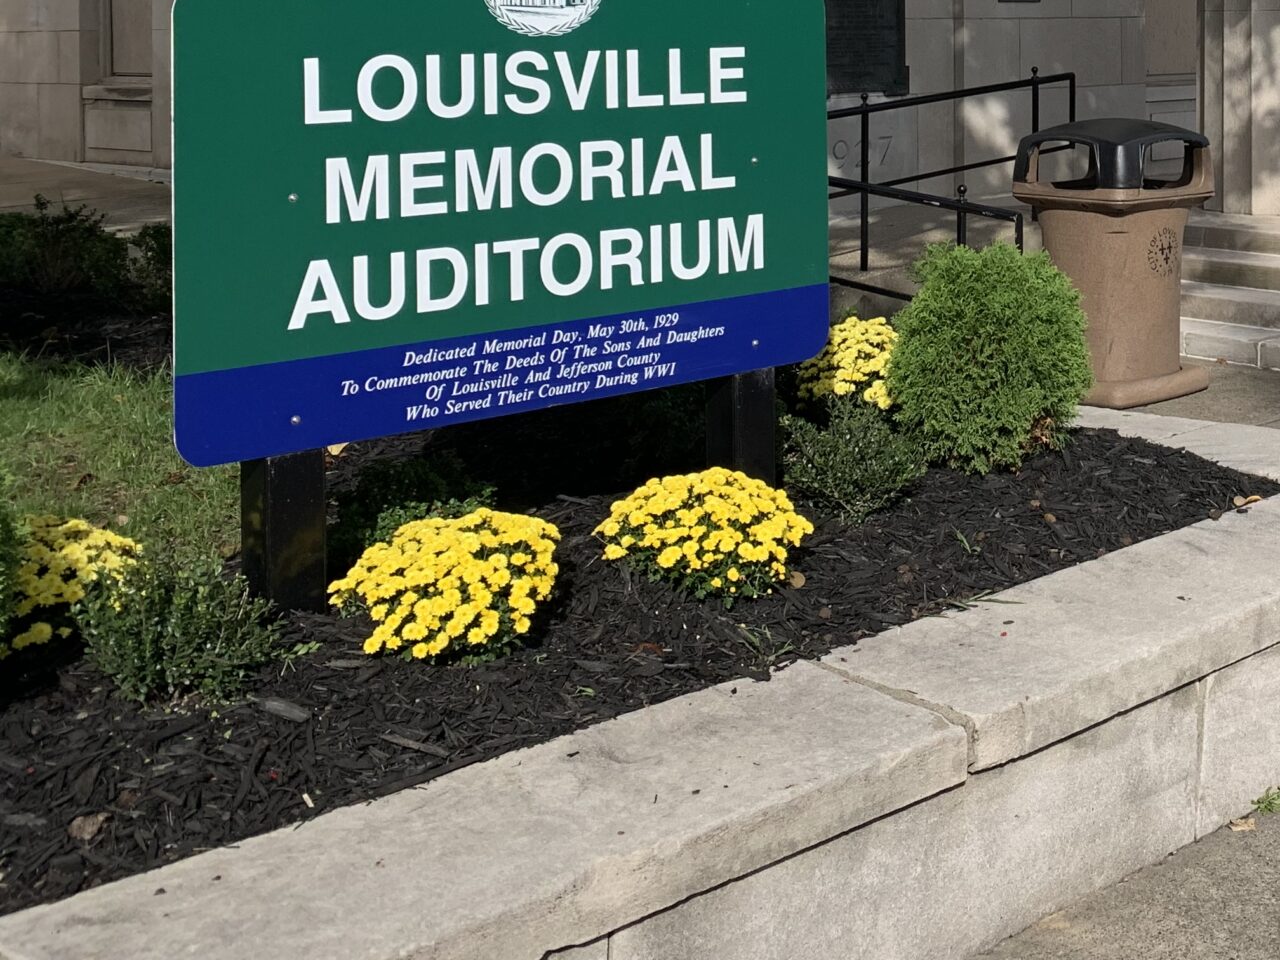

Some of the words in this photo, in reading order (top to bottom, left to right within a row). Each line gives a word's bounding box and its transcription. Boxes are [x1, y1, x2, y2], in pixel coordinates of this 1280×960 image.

[303, 46, 748, 125] LOUISVILLE
[325, 133, 737, 224] MEMORIAL
[287, 213, 765, 330] AUDITORIUM
[341, 380, 360, 396] To
[364, 365, 468, 392] Commemorate
[473, 359, 499, 375] The
[504, 352, 545, 370] Deeds
[550, 347, 568, 364] Of
[573, 344, 598, 360] The
[602, 341, 631, 355] Sons
[636, 335, 661, 350] And
[666, 325, 725, 344] Daughters
[403, 342, 477, 367] Dedicated
[482, 332, 546, 355] Memorial
[551, 329, 582, 345] Day,
[587, 324, 615, 339] May
[619, 318, 649, 334] 30th,
[653, 312, 679, 329] 1929
[405, 405, 439, 421] Who
[444, 394, 491, 415] Served
[497, 388, 534, 406] Their
[538, 380, 590, 399] Country
[594, 372, 639, 389] During
[643, 362, 677, 381] WWI
[425, 383, 446, 401] Of
[451, 373, 519, 397] Louisville
[524, 366, 551, 384] And
[556, 360, 612, 379] Jefferson
[617, 352, 661, 368] County
